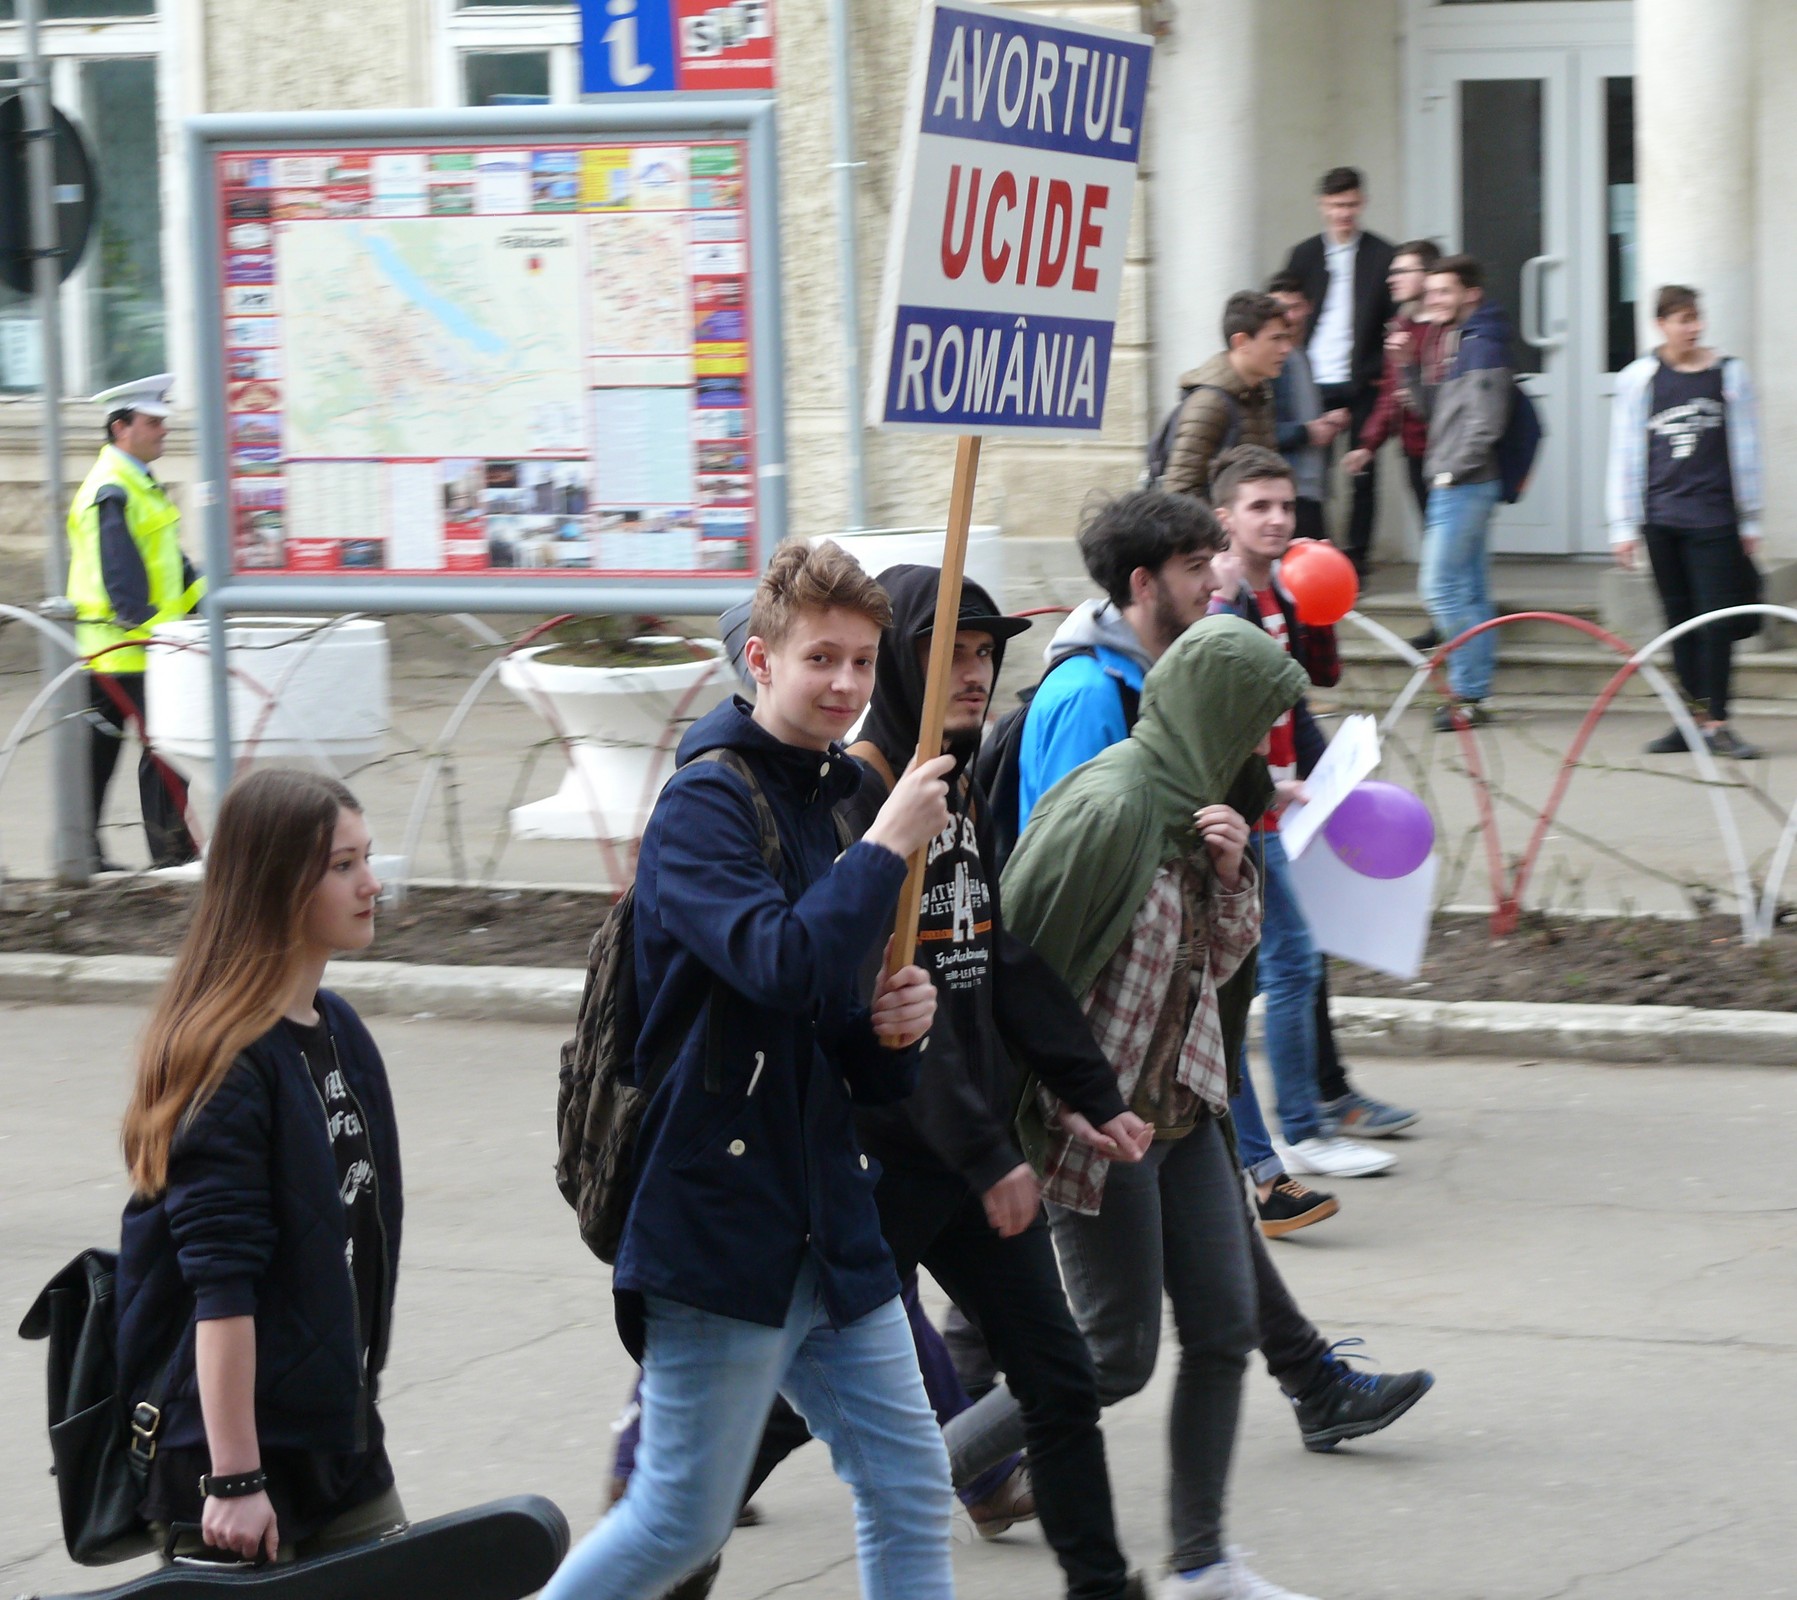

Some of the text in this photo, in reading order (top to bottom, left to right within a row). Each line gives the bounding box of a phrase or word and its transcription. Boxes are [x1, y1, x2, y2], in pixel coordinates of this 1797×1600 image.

[932, 24, 1133, 145] AVORTUL
[940, 164, 1109, 293] UCIDE
[896, 316, 1095, 418] ROMÂNIA
